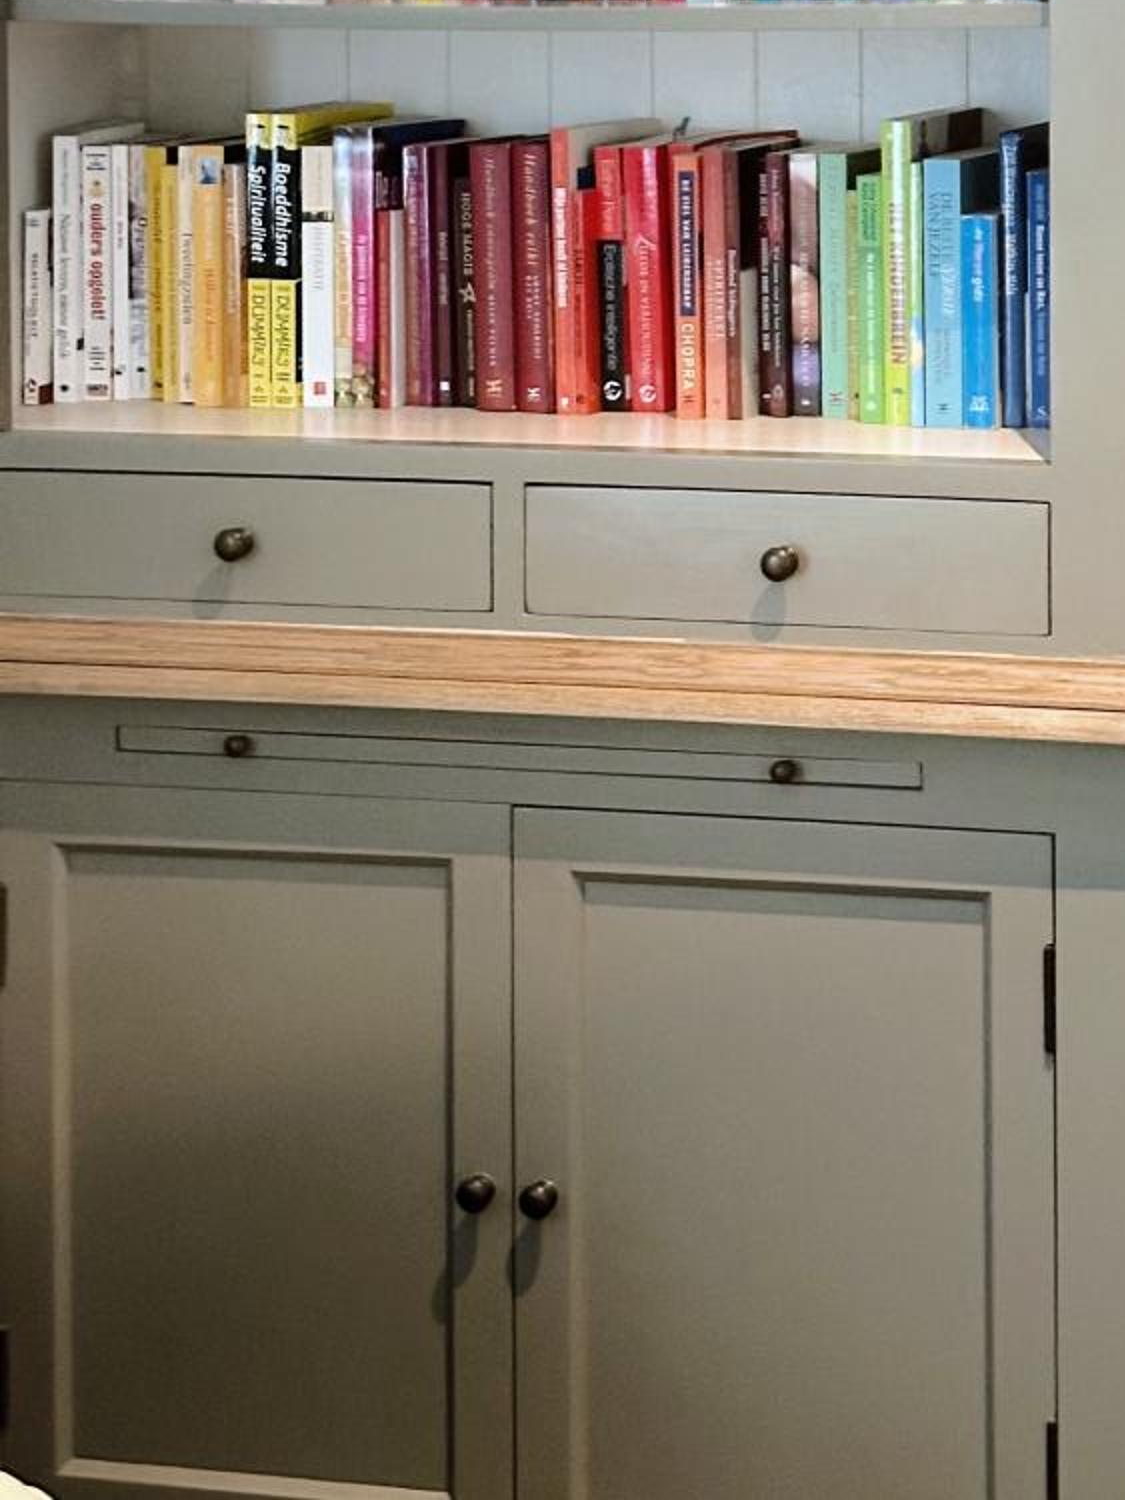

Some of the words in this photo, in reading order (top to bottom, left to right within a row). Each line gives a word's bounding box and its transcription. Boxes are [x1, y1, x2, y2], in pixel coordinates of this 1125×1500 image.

[90, 203, 105, 256] ouders
[249, 165, 266, 263] Spiritualiteit
[274, 162, 291, 267] Boeddhisme
[682, 220, 690, 239] VAN
[90, 261, 106, 321] opgelet!
[681, 323, 695, 390] CHOPRA
